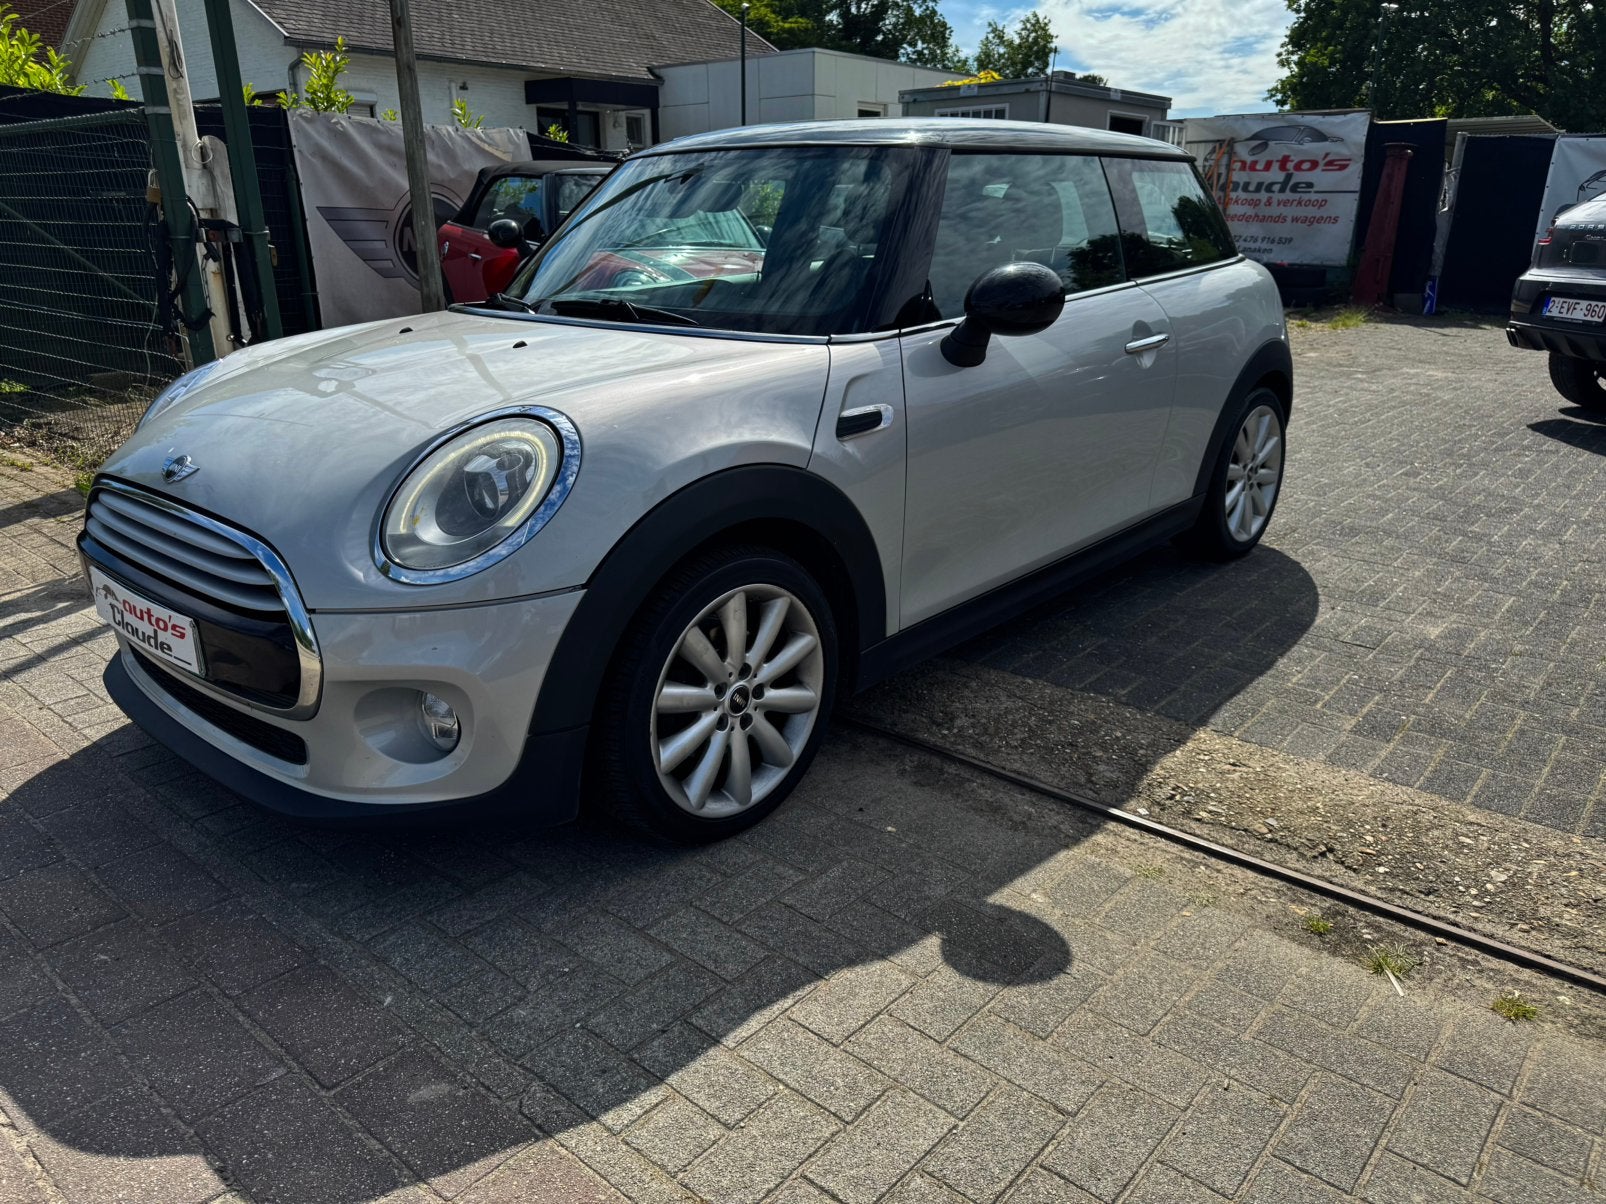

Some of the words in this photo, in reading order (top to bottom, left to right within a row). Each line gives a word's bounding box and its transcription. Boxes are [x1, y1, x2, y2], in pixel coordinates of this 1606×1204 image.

[1230, 152, 1352, 172] auto's
[1213, 173, 1314, 194] laude
[1263, 196, 1273, 206] &
[1276, 197, 1328, 210] verkoop
[1225, 212, 1287, 224] eedehands
[1290, 214, 1340, 227] wagens
[1260, 235, 1276, 245] 916
[1277, 237, 1293, 246] 539
[109, 602, 173, 657] Claude
[122, 599, 186, 640] auto's
